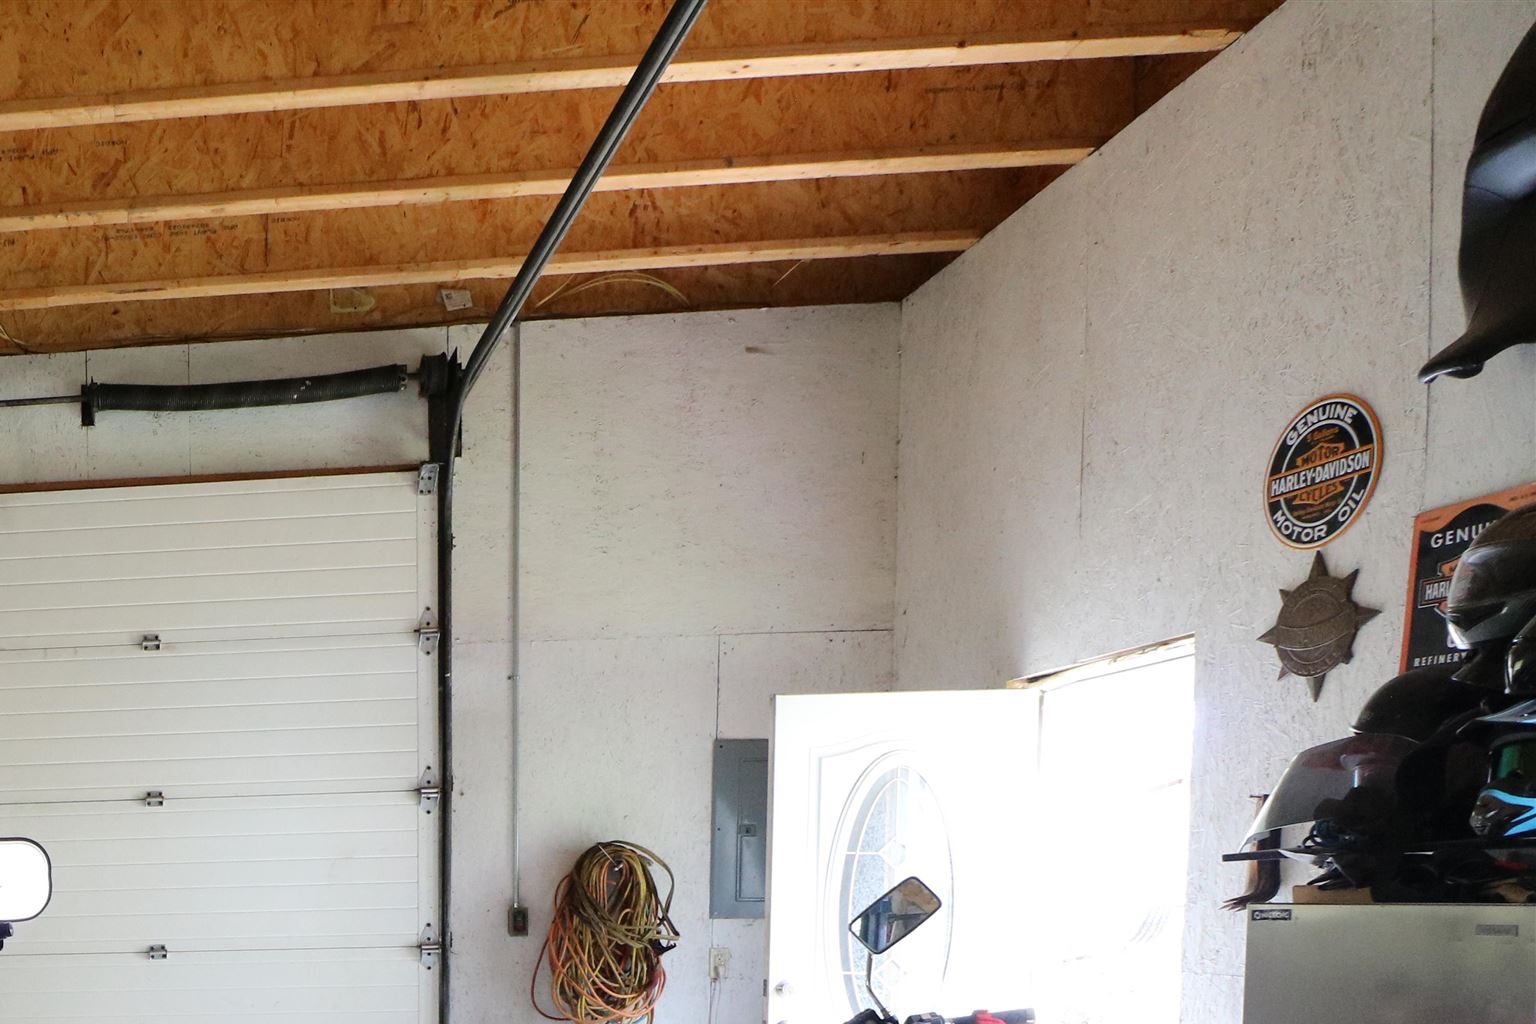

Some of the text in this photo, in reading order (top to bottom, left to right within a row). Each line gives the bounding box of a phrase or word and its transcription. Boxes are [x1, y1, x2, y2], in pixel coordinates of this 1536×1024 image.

[1286, 403, 1358, 446] GENUINE
[1270, 450, 1371, 497] HARLEY-DAVIDSON
[1273, 509, 1328, 542] MOTOR
[1337, 488, 1365, 522] OIL
[1430, 521, 1494, 549] GENU
